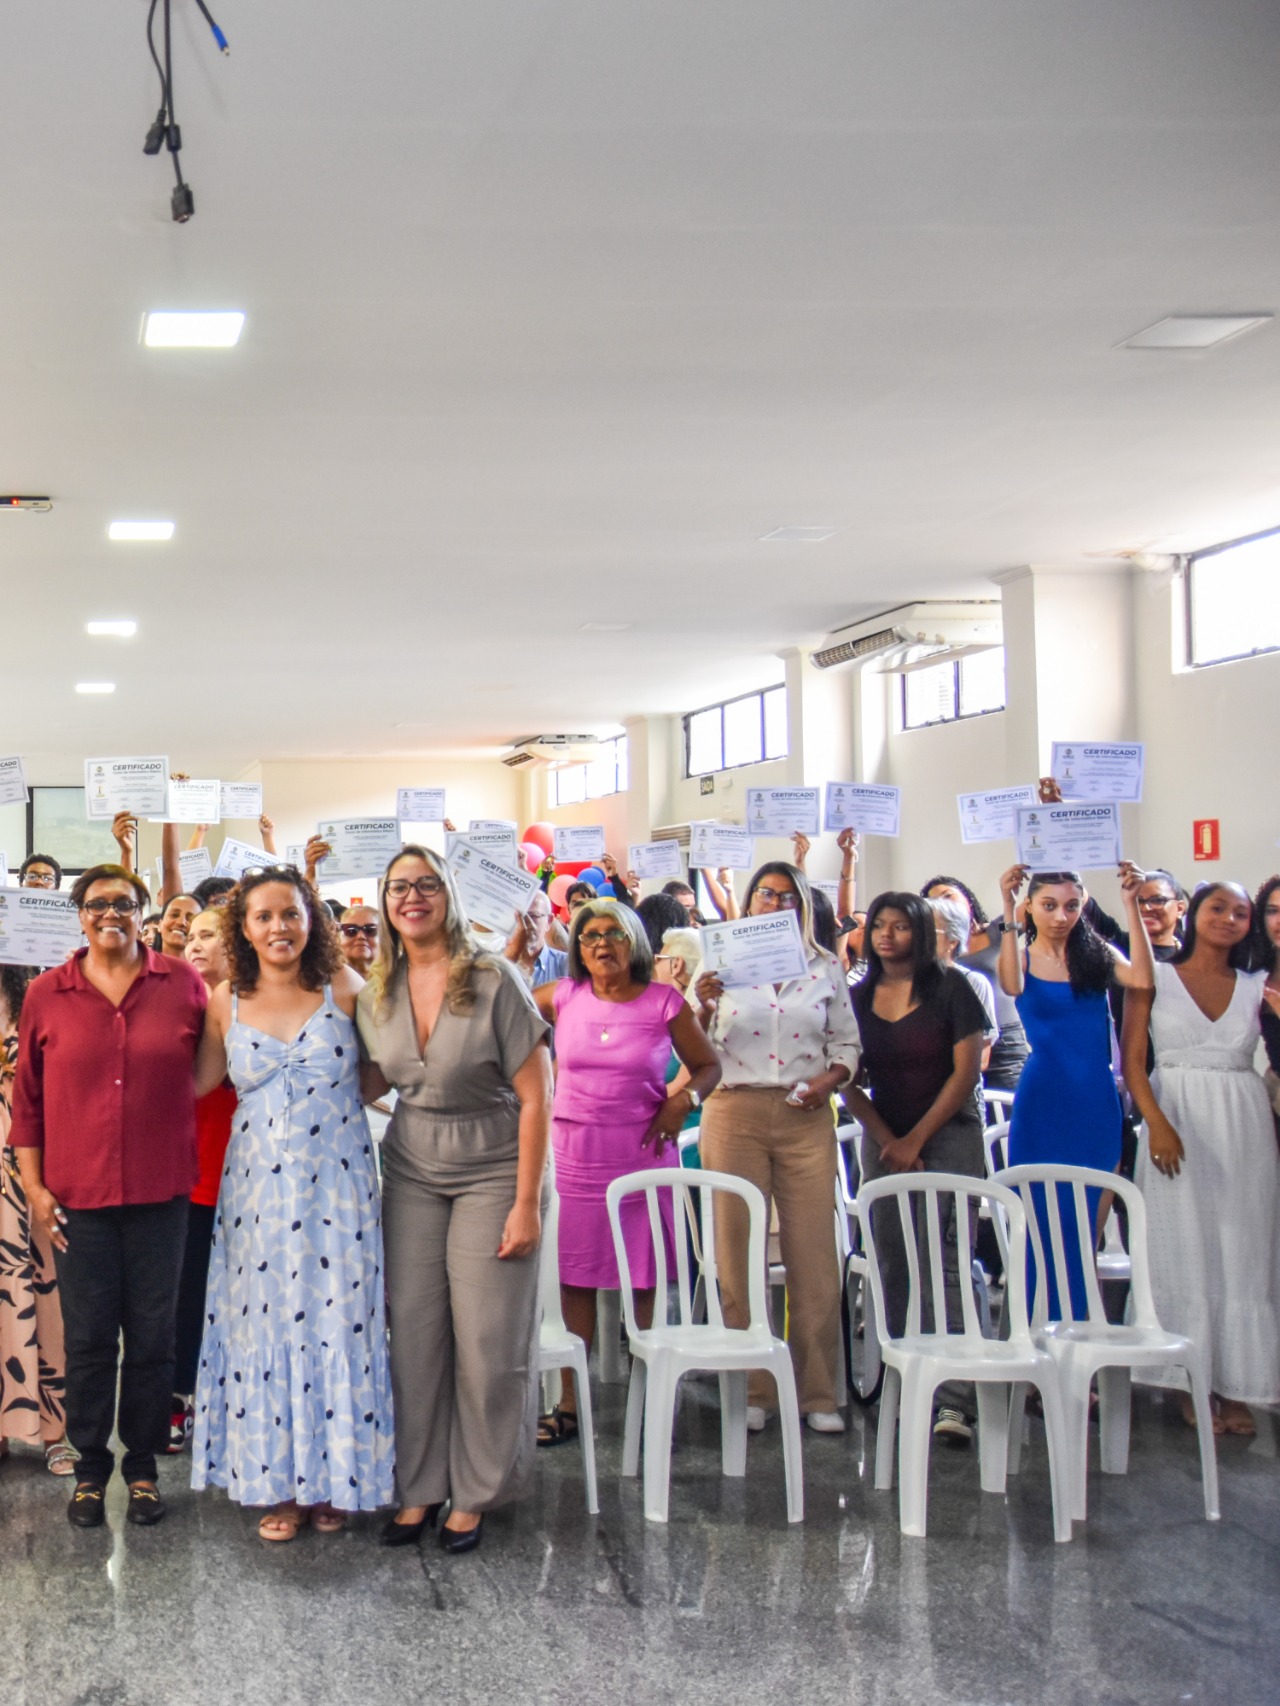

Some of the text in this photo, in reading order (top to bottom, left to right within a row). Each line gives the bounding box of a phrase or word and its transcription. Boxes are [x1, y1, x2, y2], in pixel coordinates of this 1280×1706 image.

[1083, 748, 1136, 756] CERTIFICADO
[113, 763, 161, 771] CERTIFICADO
[851, 788, 894, 797] CERTIFICADO
[984, 791, 1029, 802] CERTIFICADO
[1050, 808, 1111, 818] CERTIFICADO
[345, 823, 394, 831] CERTIFICADO
[480, 858, 531, 889] CERTIFICADO
[732, 919, 789, 936] CERTIFICADO
